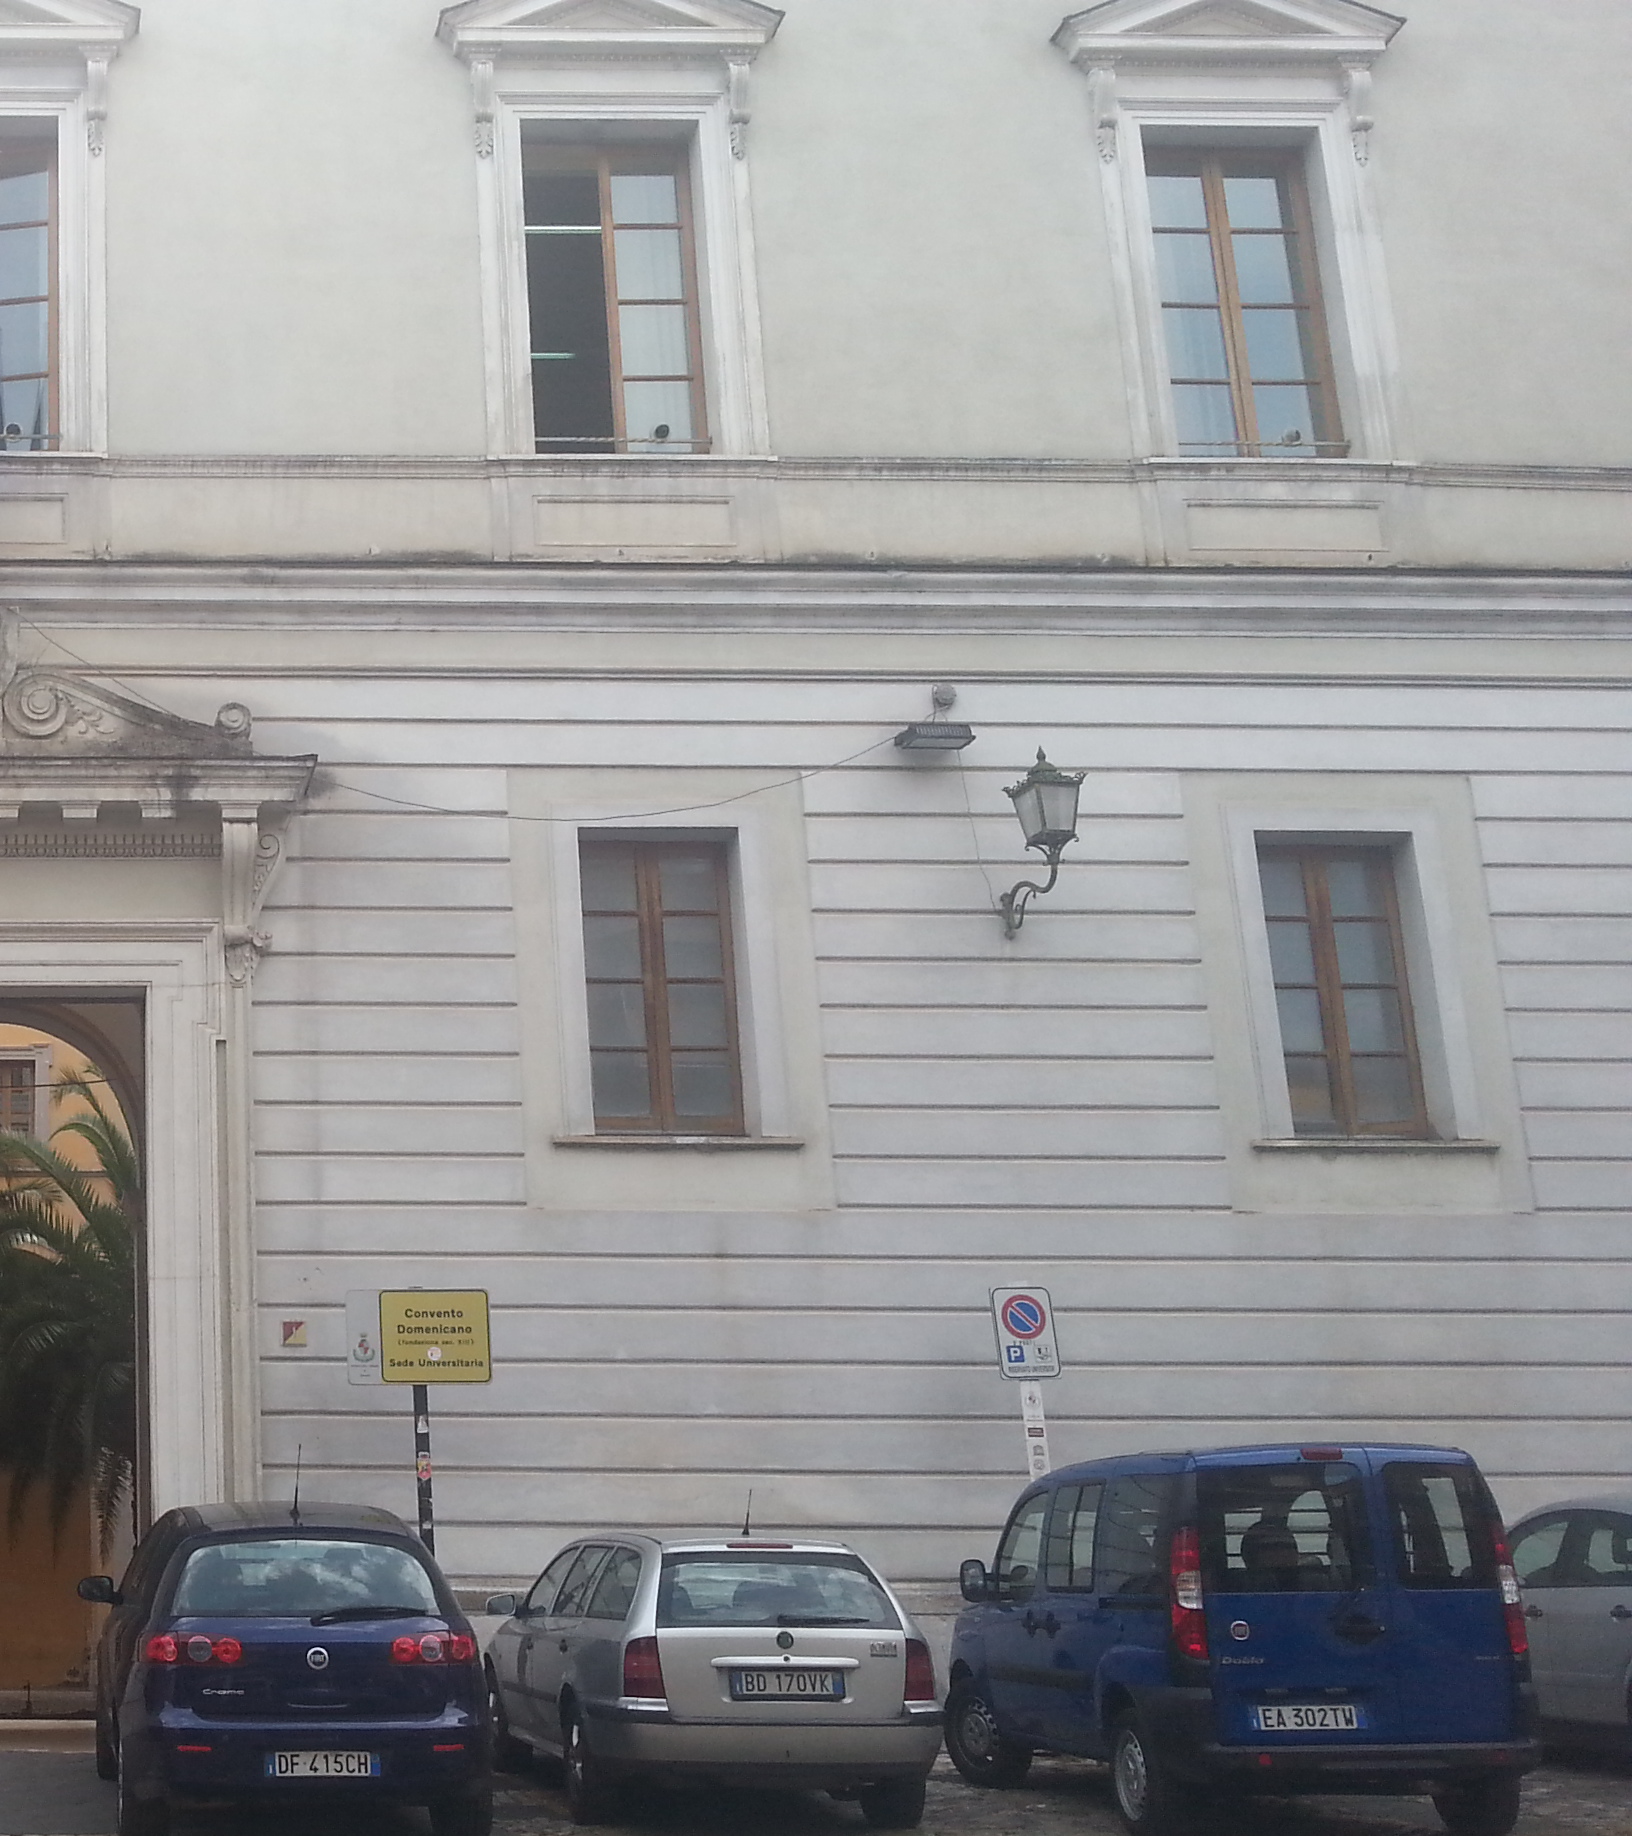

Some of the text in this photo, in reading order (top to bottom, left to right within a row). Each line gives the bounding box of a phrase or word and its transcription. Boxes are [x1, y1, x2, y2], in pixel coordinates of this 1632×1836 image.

[404, 1308, 464, 1319] Convento
[396, 1324, 473, 1334] Domenicano
[389, 1358, 484, 1368] Sede Universitaria
[744, 1673, 831, 1692] BD 170VK
[1262, 1706, 1356, 1728] EA 302TW
[277, 1754, 369, 1774] DF 415CH
